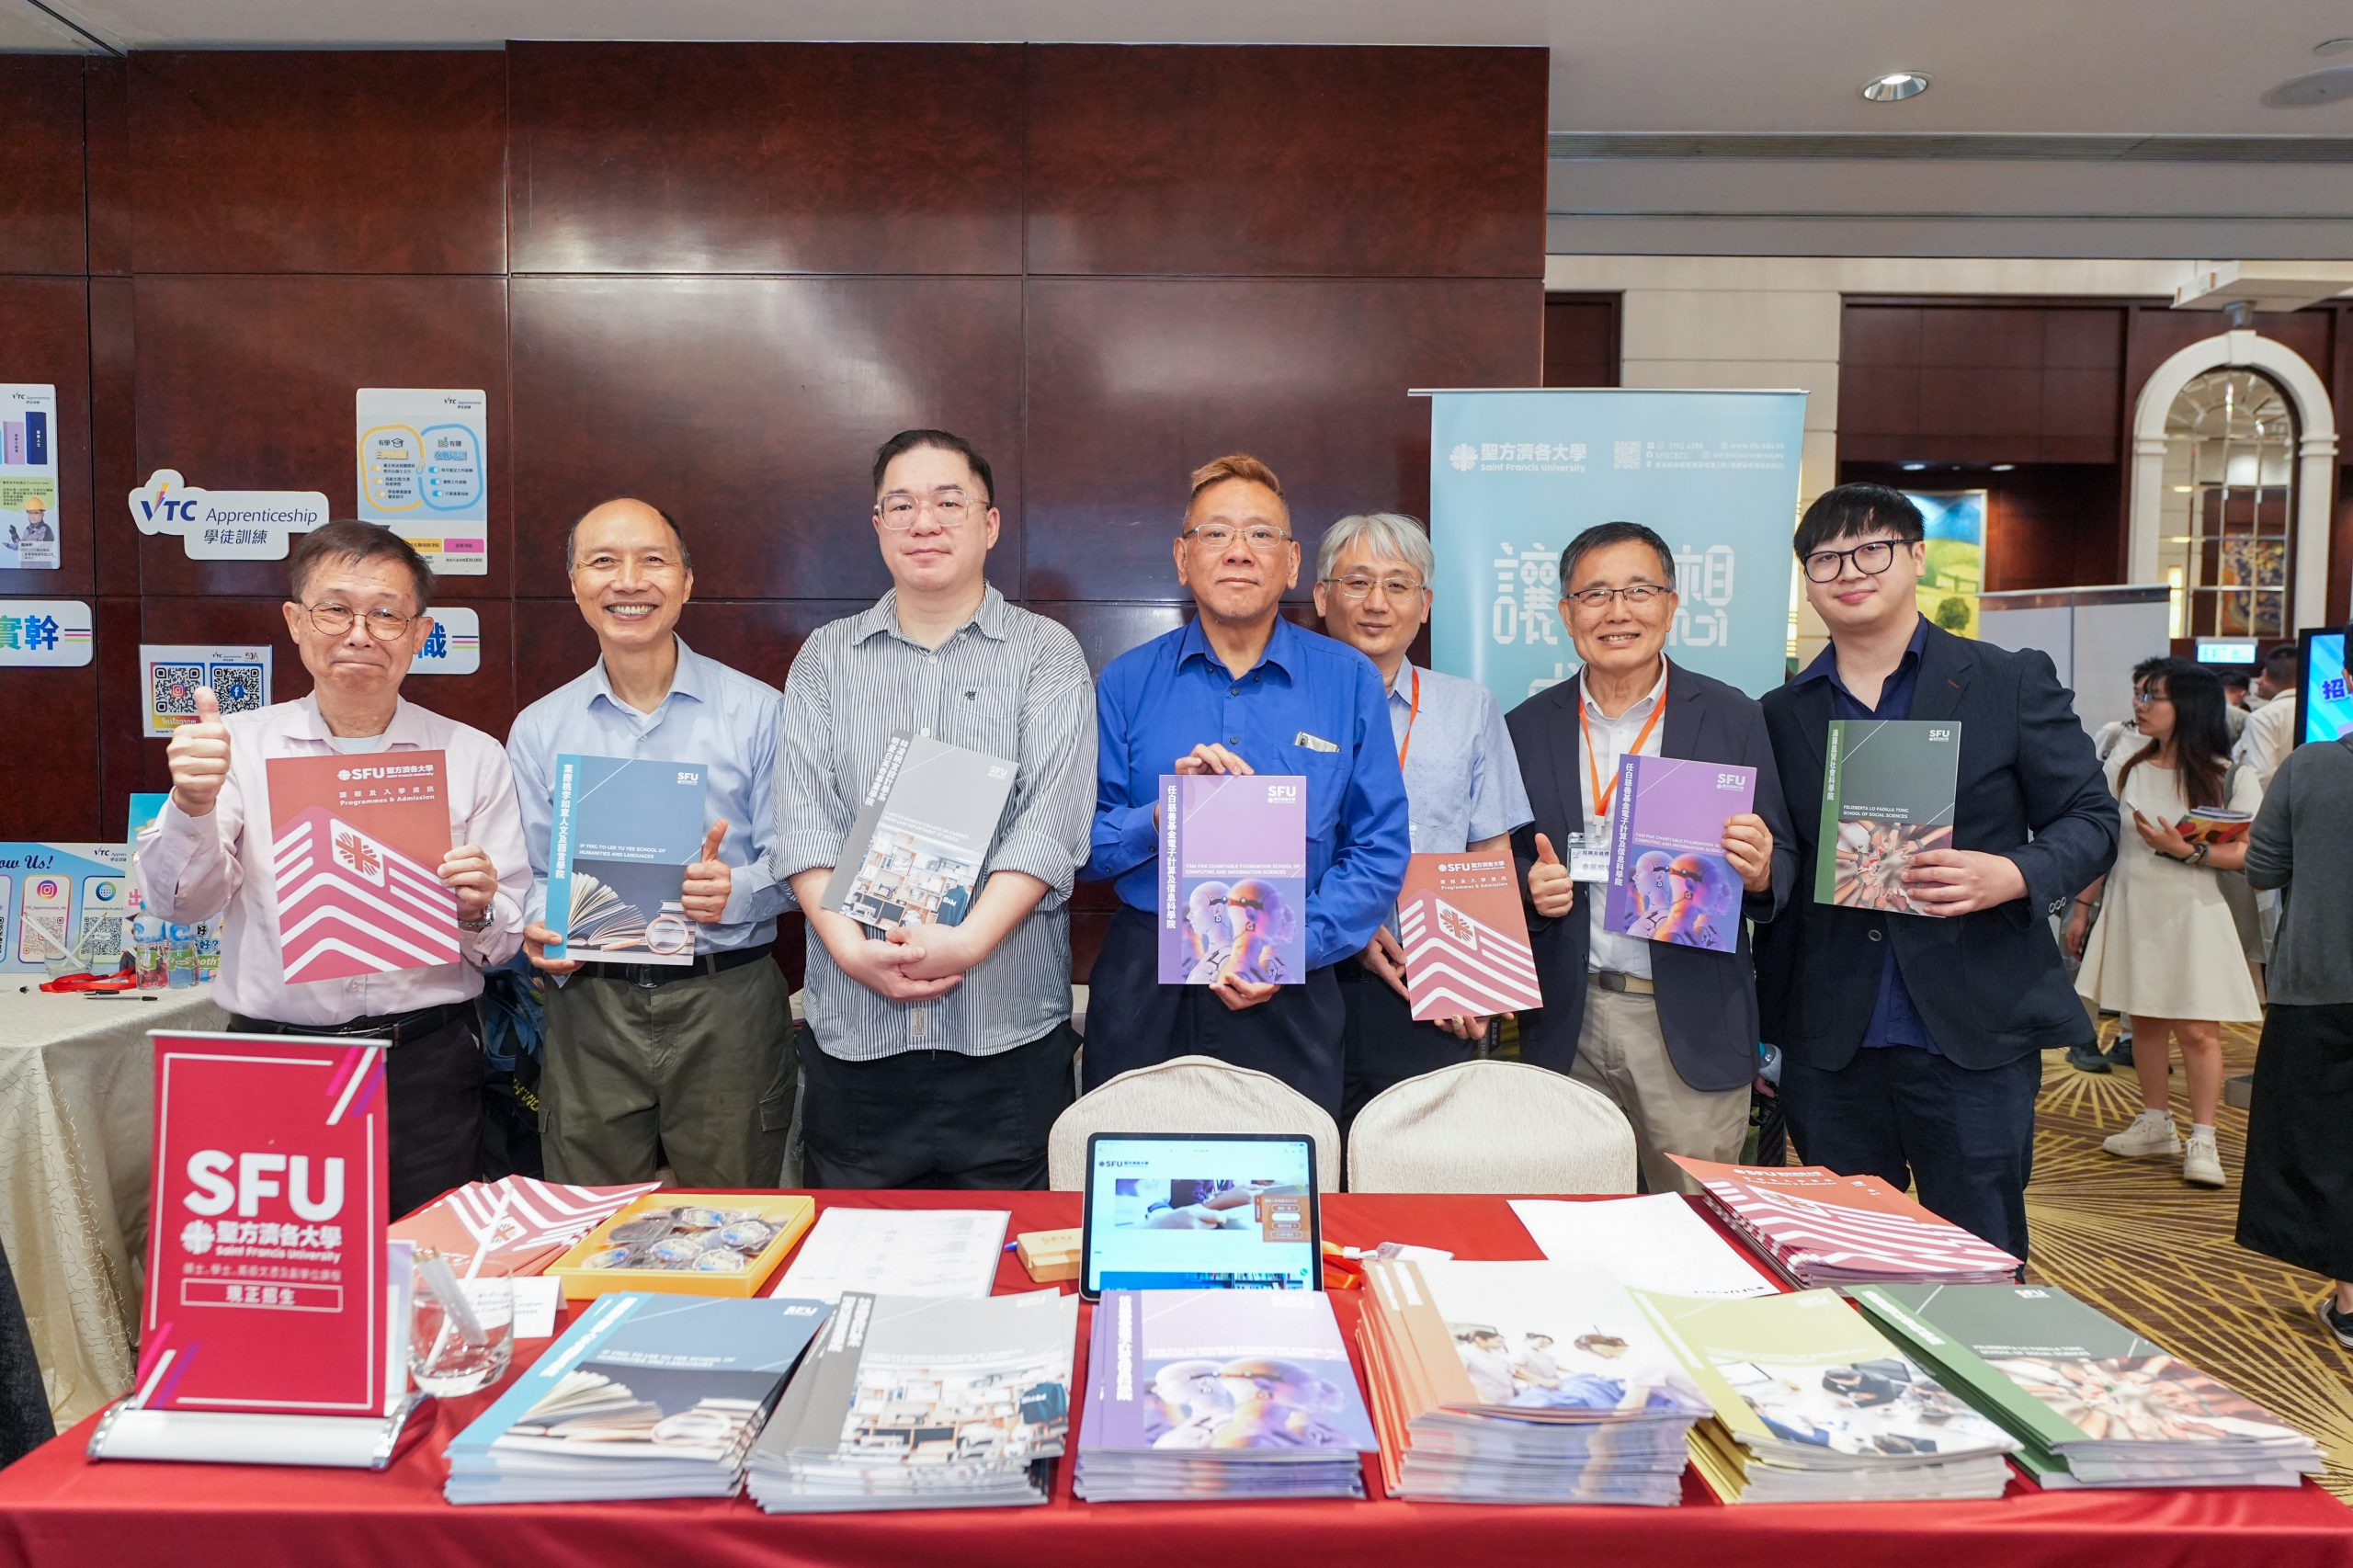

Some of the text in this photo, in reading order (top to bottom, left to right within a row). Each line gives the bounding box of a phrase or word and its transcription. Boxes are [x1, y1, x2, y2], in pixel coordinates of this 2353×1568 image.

[1481, 442, 1587, 461] 聖方濟各大學
[1481, 463, 1586, 473] Saint Francis University
[140, 482, 318, 526] VTC Apprenticeship
[203, 528, 268, 545] 學徒訓練
[1929, 730, 1949, 738] SFU
[351, 767, 385, 780] SFU
[386, 764, 434, 774] 聖方濟各大學
[989, 766, 1008, 777] SFU
[677, 772, 699, 781] SFU
[1717, 773, 1745, 786] SFU
[1267, 786, 1296, 797] SFU
[339, 798, 388, 806] Programmes
[1656, 835, 1683, 843] CHARITABLE
[1683, 838, 1714, 847] FOUNDATION
[1672, 843, 1705, 851] INFORMATION
[94, 846, 110, 856] VTC
[25, 855, 54, 869] Us!
[1448, 863, 1471, 872] SFU
[182, 1149, 345, 1221] SFU
[215, 1220, 342, 1249] 聖方濟各大學
[215, 1244, 342, 1264] Saint Francis University
[225, 1285, 296, 1305] 現正招生
